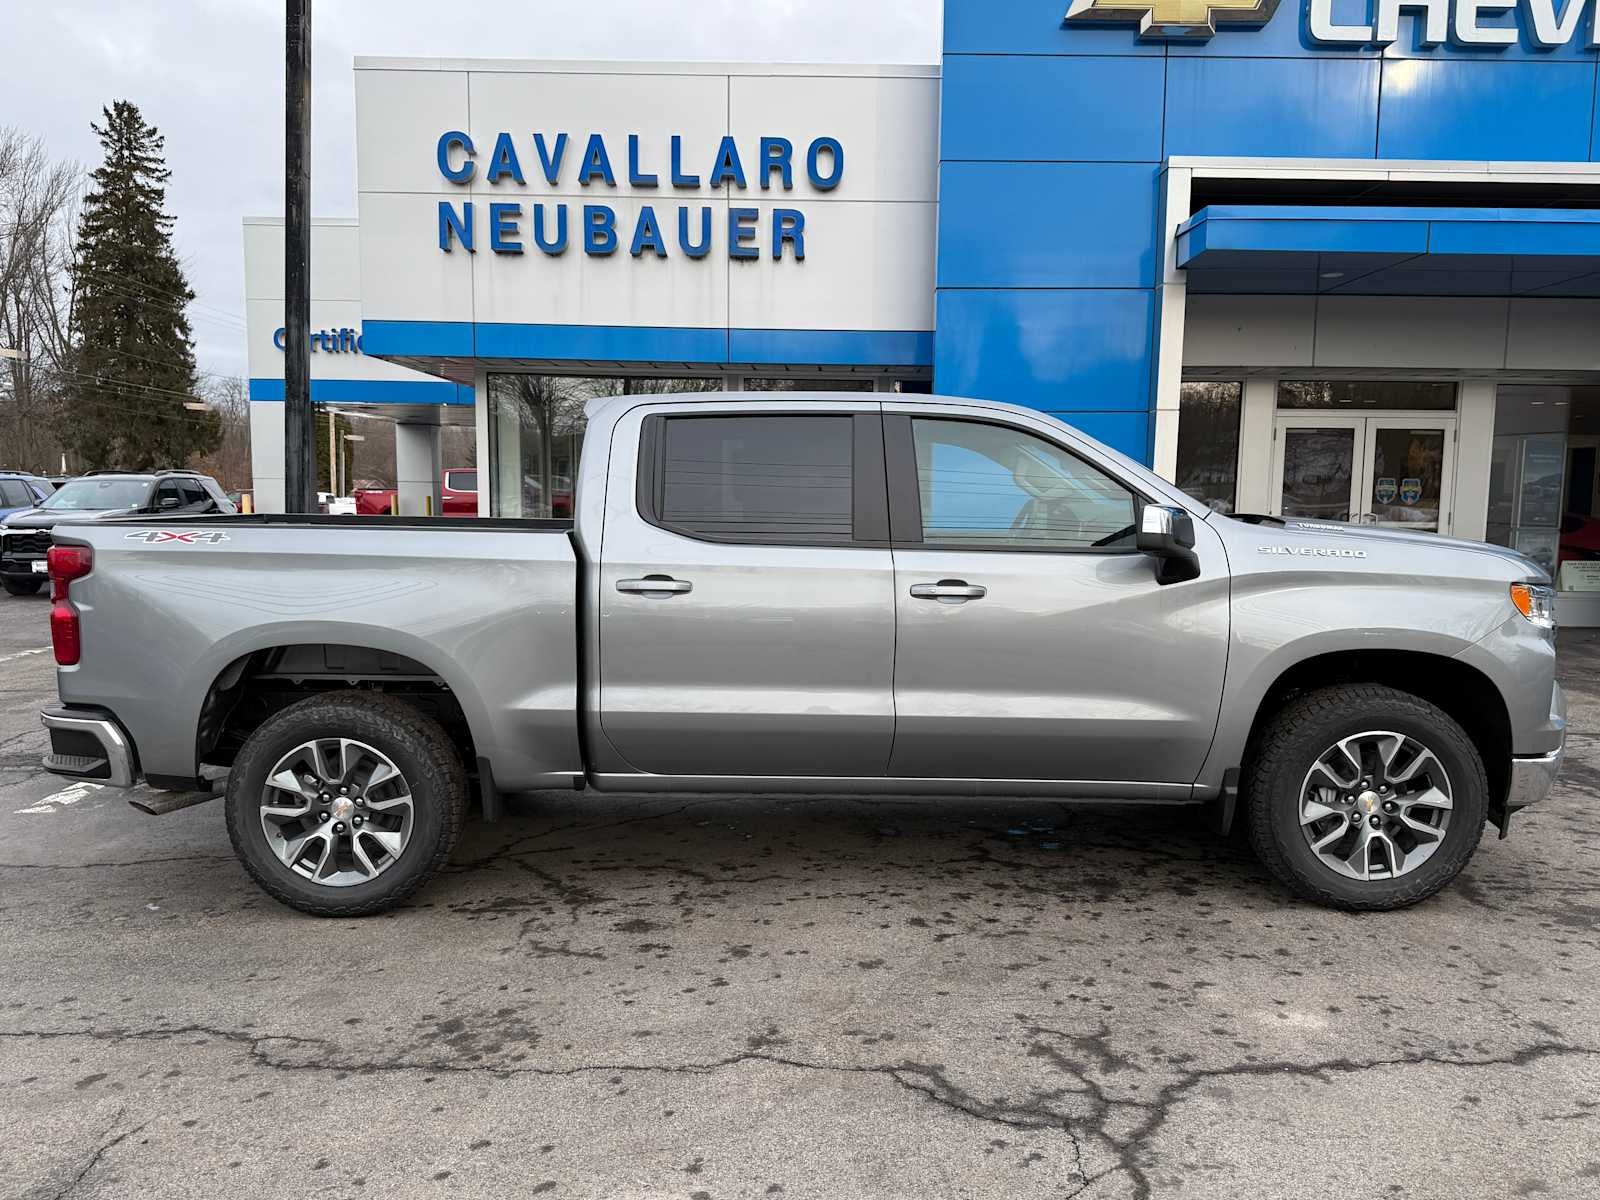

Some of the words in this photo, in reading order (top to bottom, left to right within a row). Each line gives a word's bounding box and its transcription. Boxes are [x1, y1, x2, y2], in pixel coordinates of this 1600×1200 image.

[1303, 0, 1600, 46] CHEV
[437, 130, 845, 191] CAVALLARO
[438, 201, 806, 260] NEUBAUER
[273, 327, 363, 353] Crtifi
[1257, 546, 1368, 558] SILVERADO
